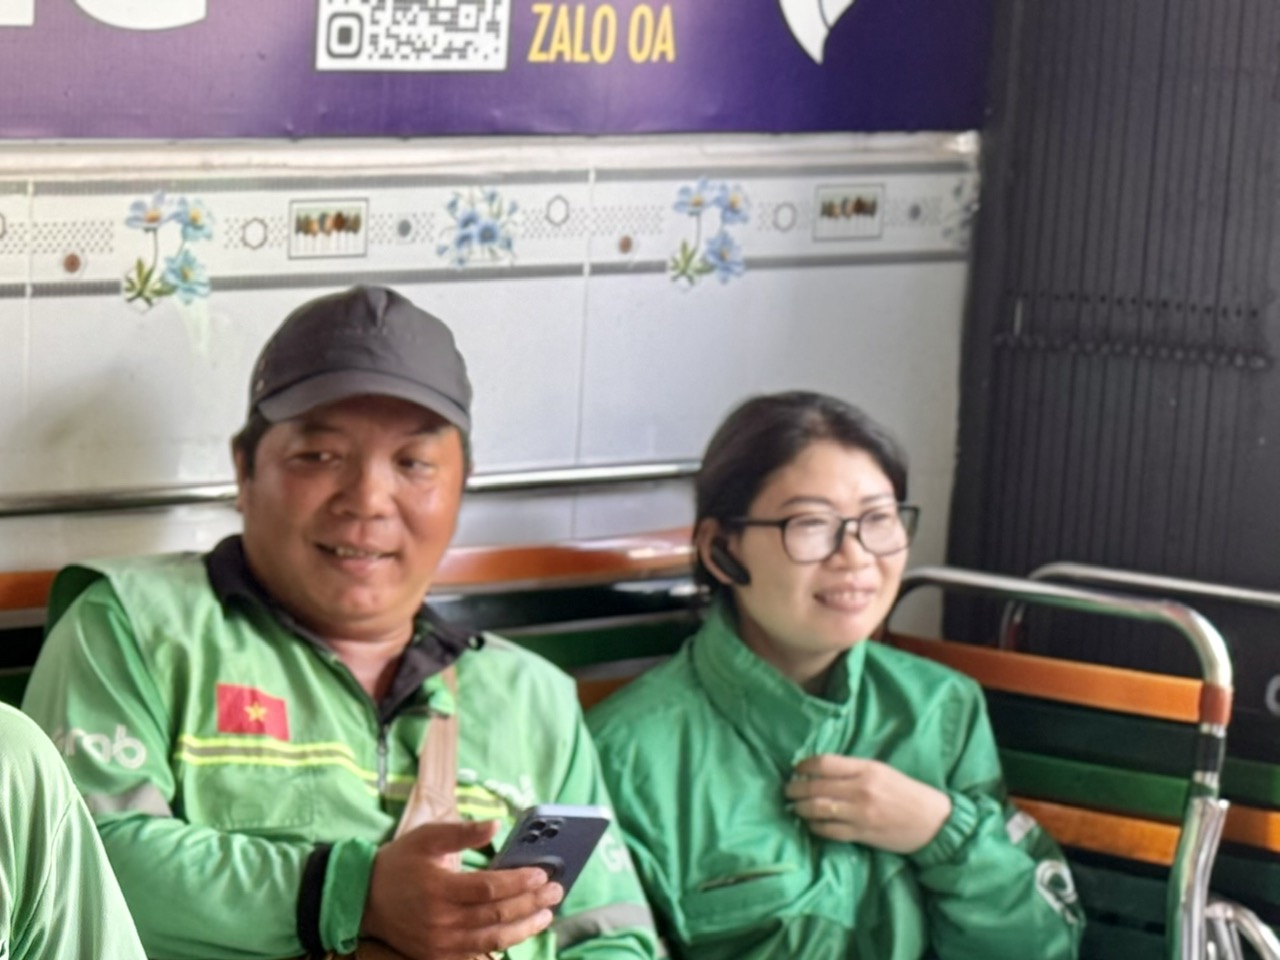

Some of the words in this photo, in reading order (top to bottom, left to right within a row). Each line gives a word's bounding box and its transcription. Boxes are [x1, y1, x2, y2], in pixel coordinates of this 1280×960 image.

[527, 3, 617, 64] ZALO
[628, 3, 675, 63] OA
[53, 724, 147, 770] rab
